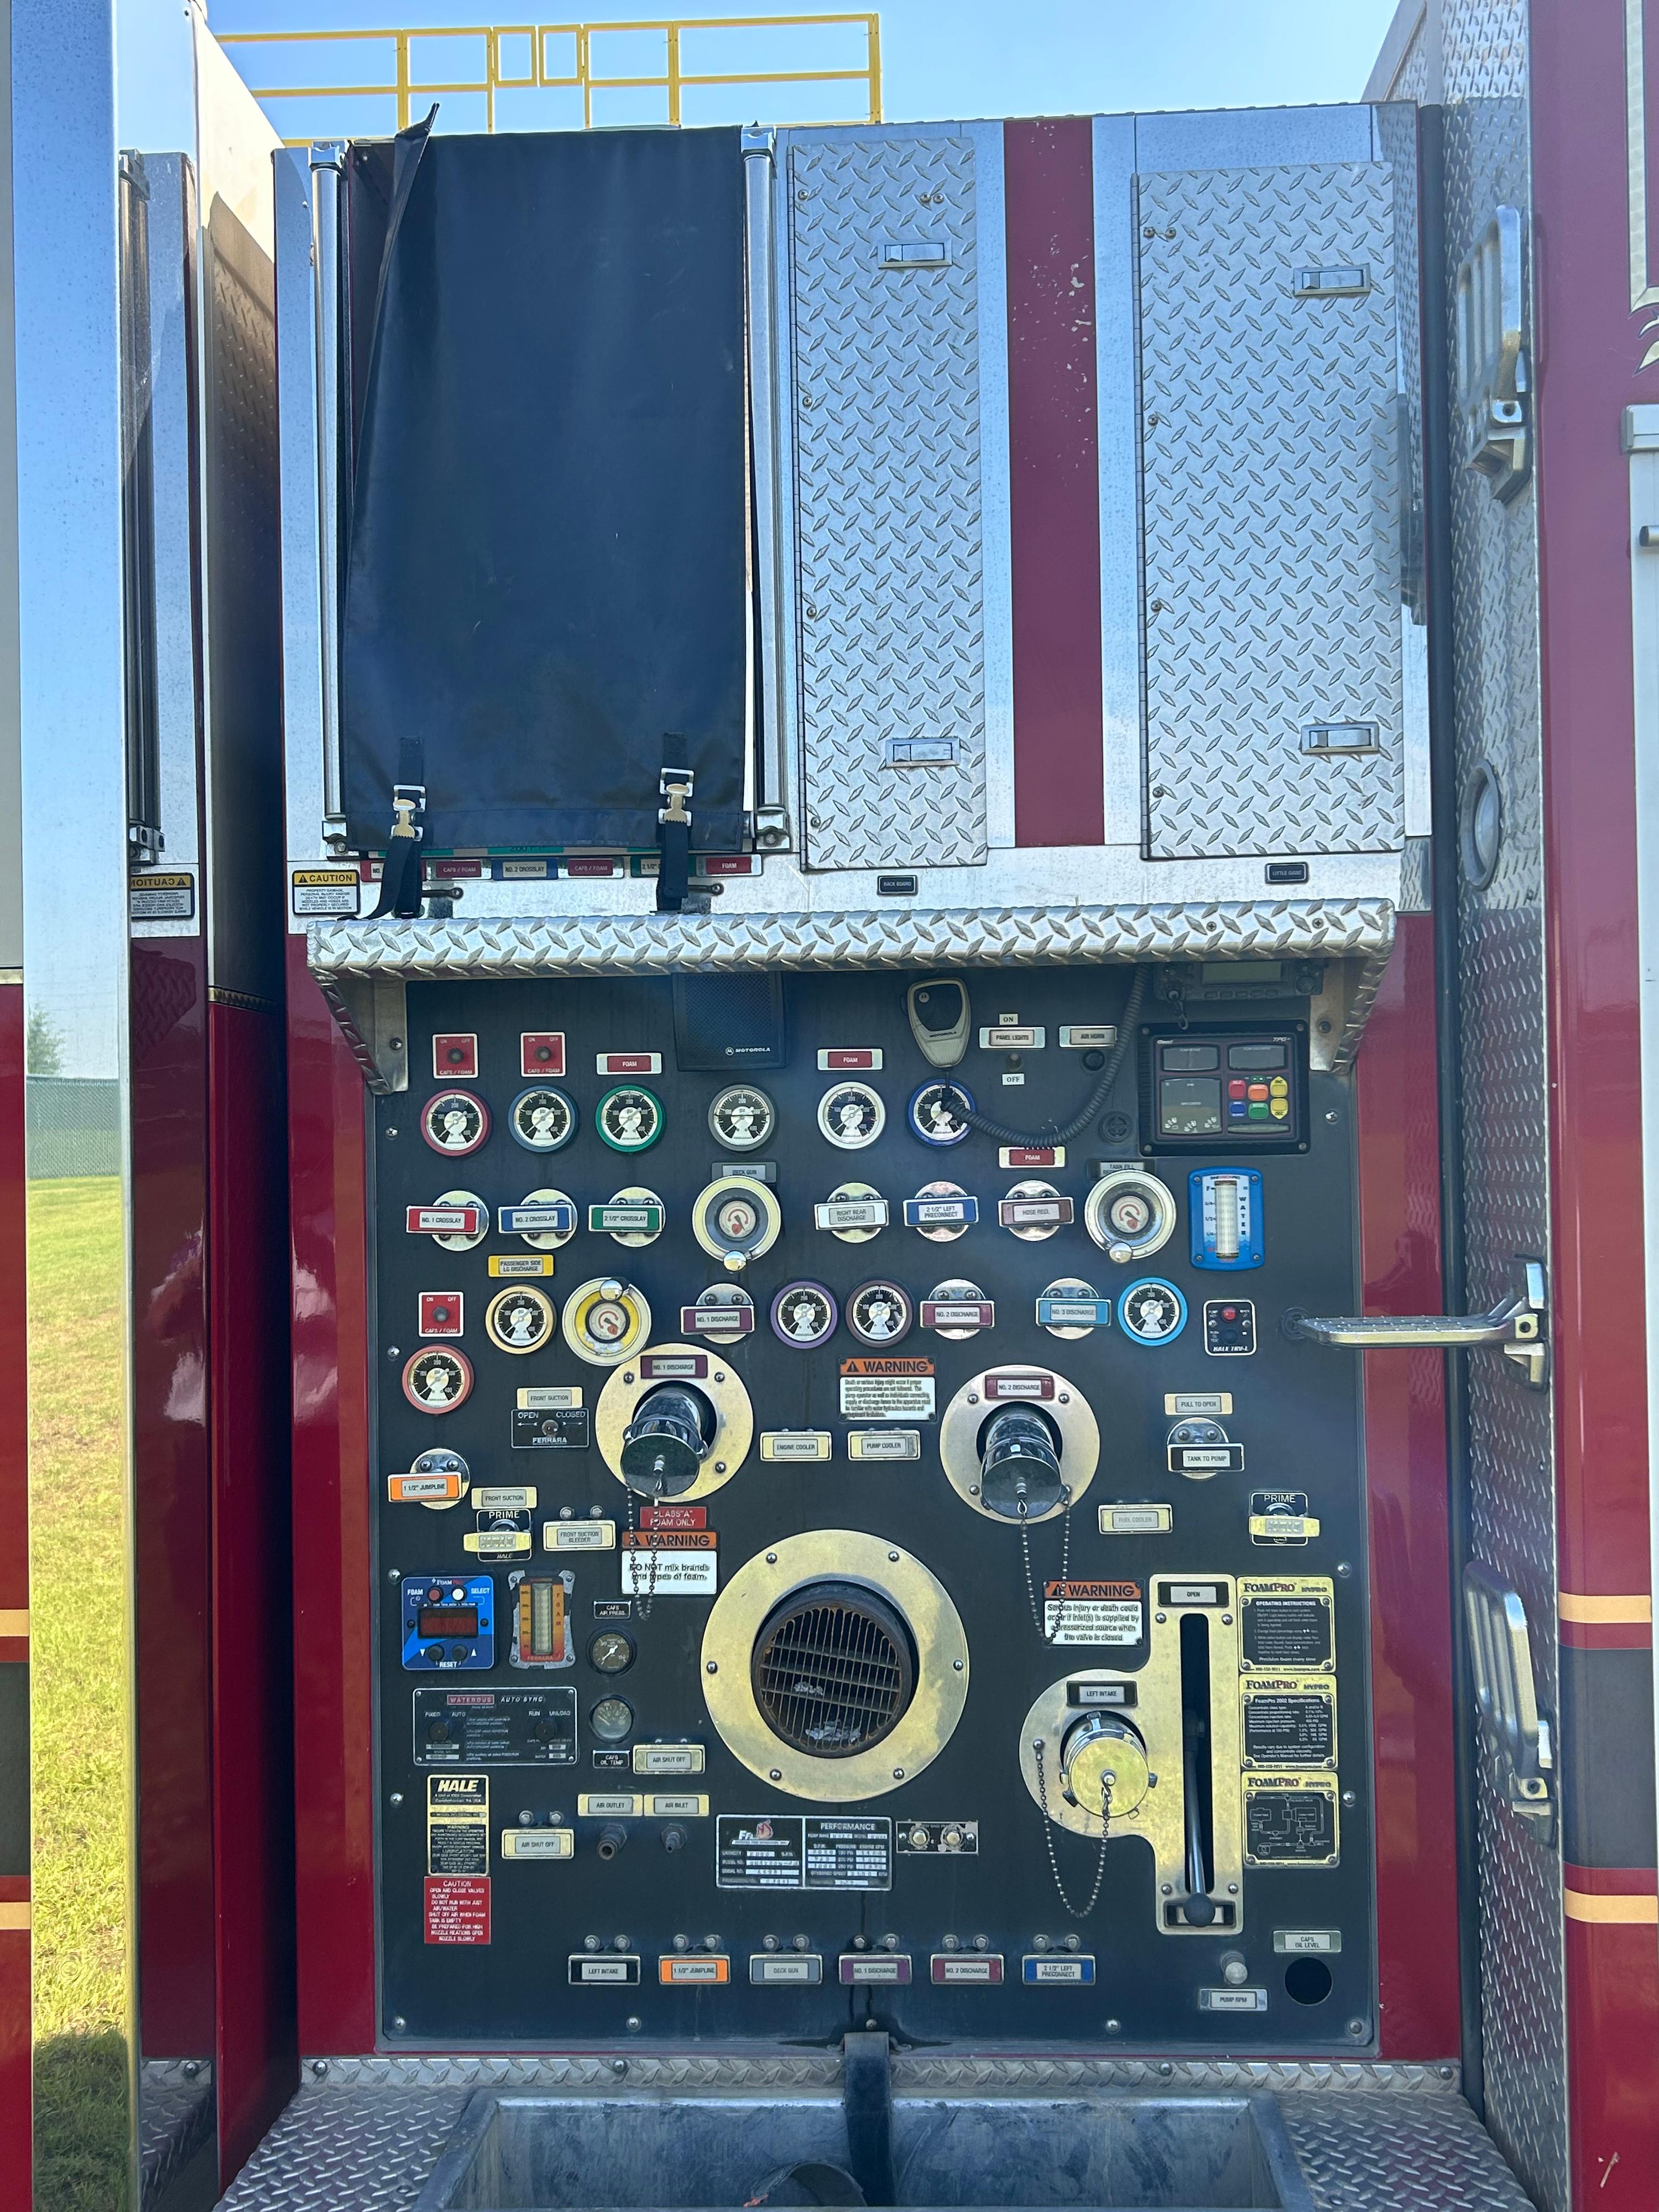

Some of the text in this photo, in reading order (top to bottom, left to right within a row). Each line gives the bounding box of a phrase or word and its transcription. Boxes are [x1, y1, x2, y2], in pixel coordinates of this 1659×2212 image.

[863, 1361, 928, 1373] WARNING
[1264, 1494, 1296, 1503] PRIME
[489, 1510, 520, 1519] PRIME
[645, 1535, 710, 1546] WARNING
[1068, 1584, 1135, 1597] WARNING
[1073, 1604, 1090, 1613] injury
[1102, 1614, 1129, 1623] supplied
[1131, 1615, 1139, 1623] by
[437, 1780, 479, 1792] HALE
